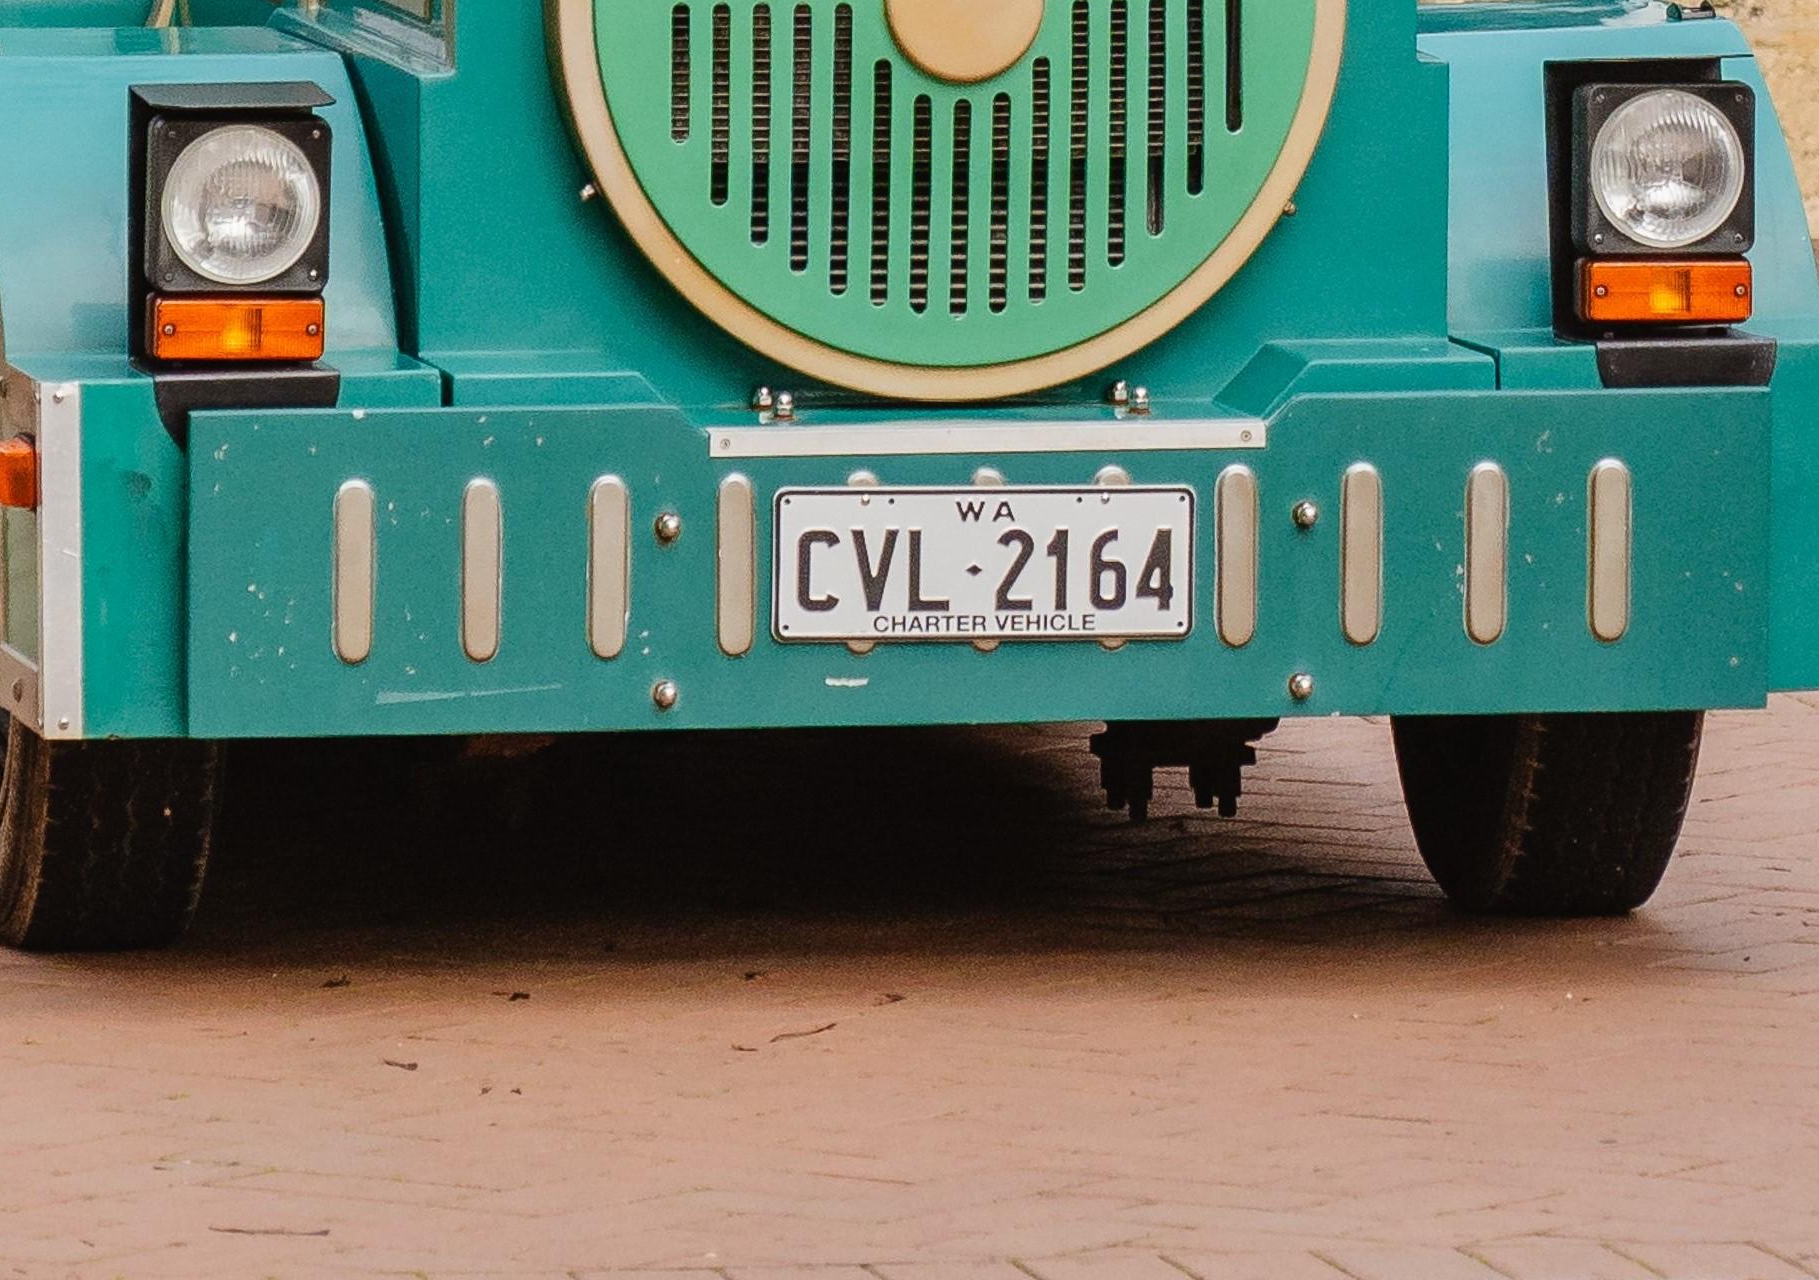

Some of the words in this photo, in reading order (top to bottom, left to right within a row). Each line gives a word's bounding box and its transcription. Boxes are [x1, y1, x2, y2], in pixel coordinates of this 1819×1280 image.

[956, 500, 1016, 523] WA
[873, 616, 986, 633] CHARTER
[995, 614, 1095, 632] VEHICLE
